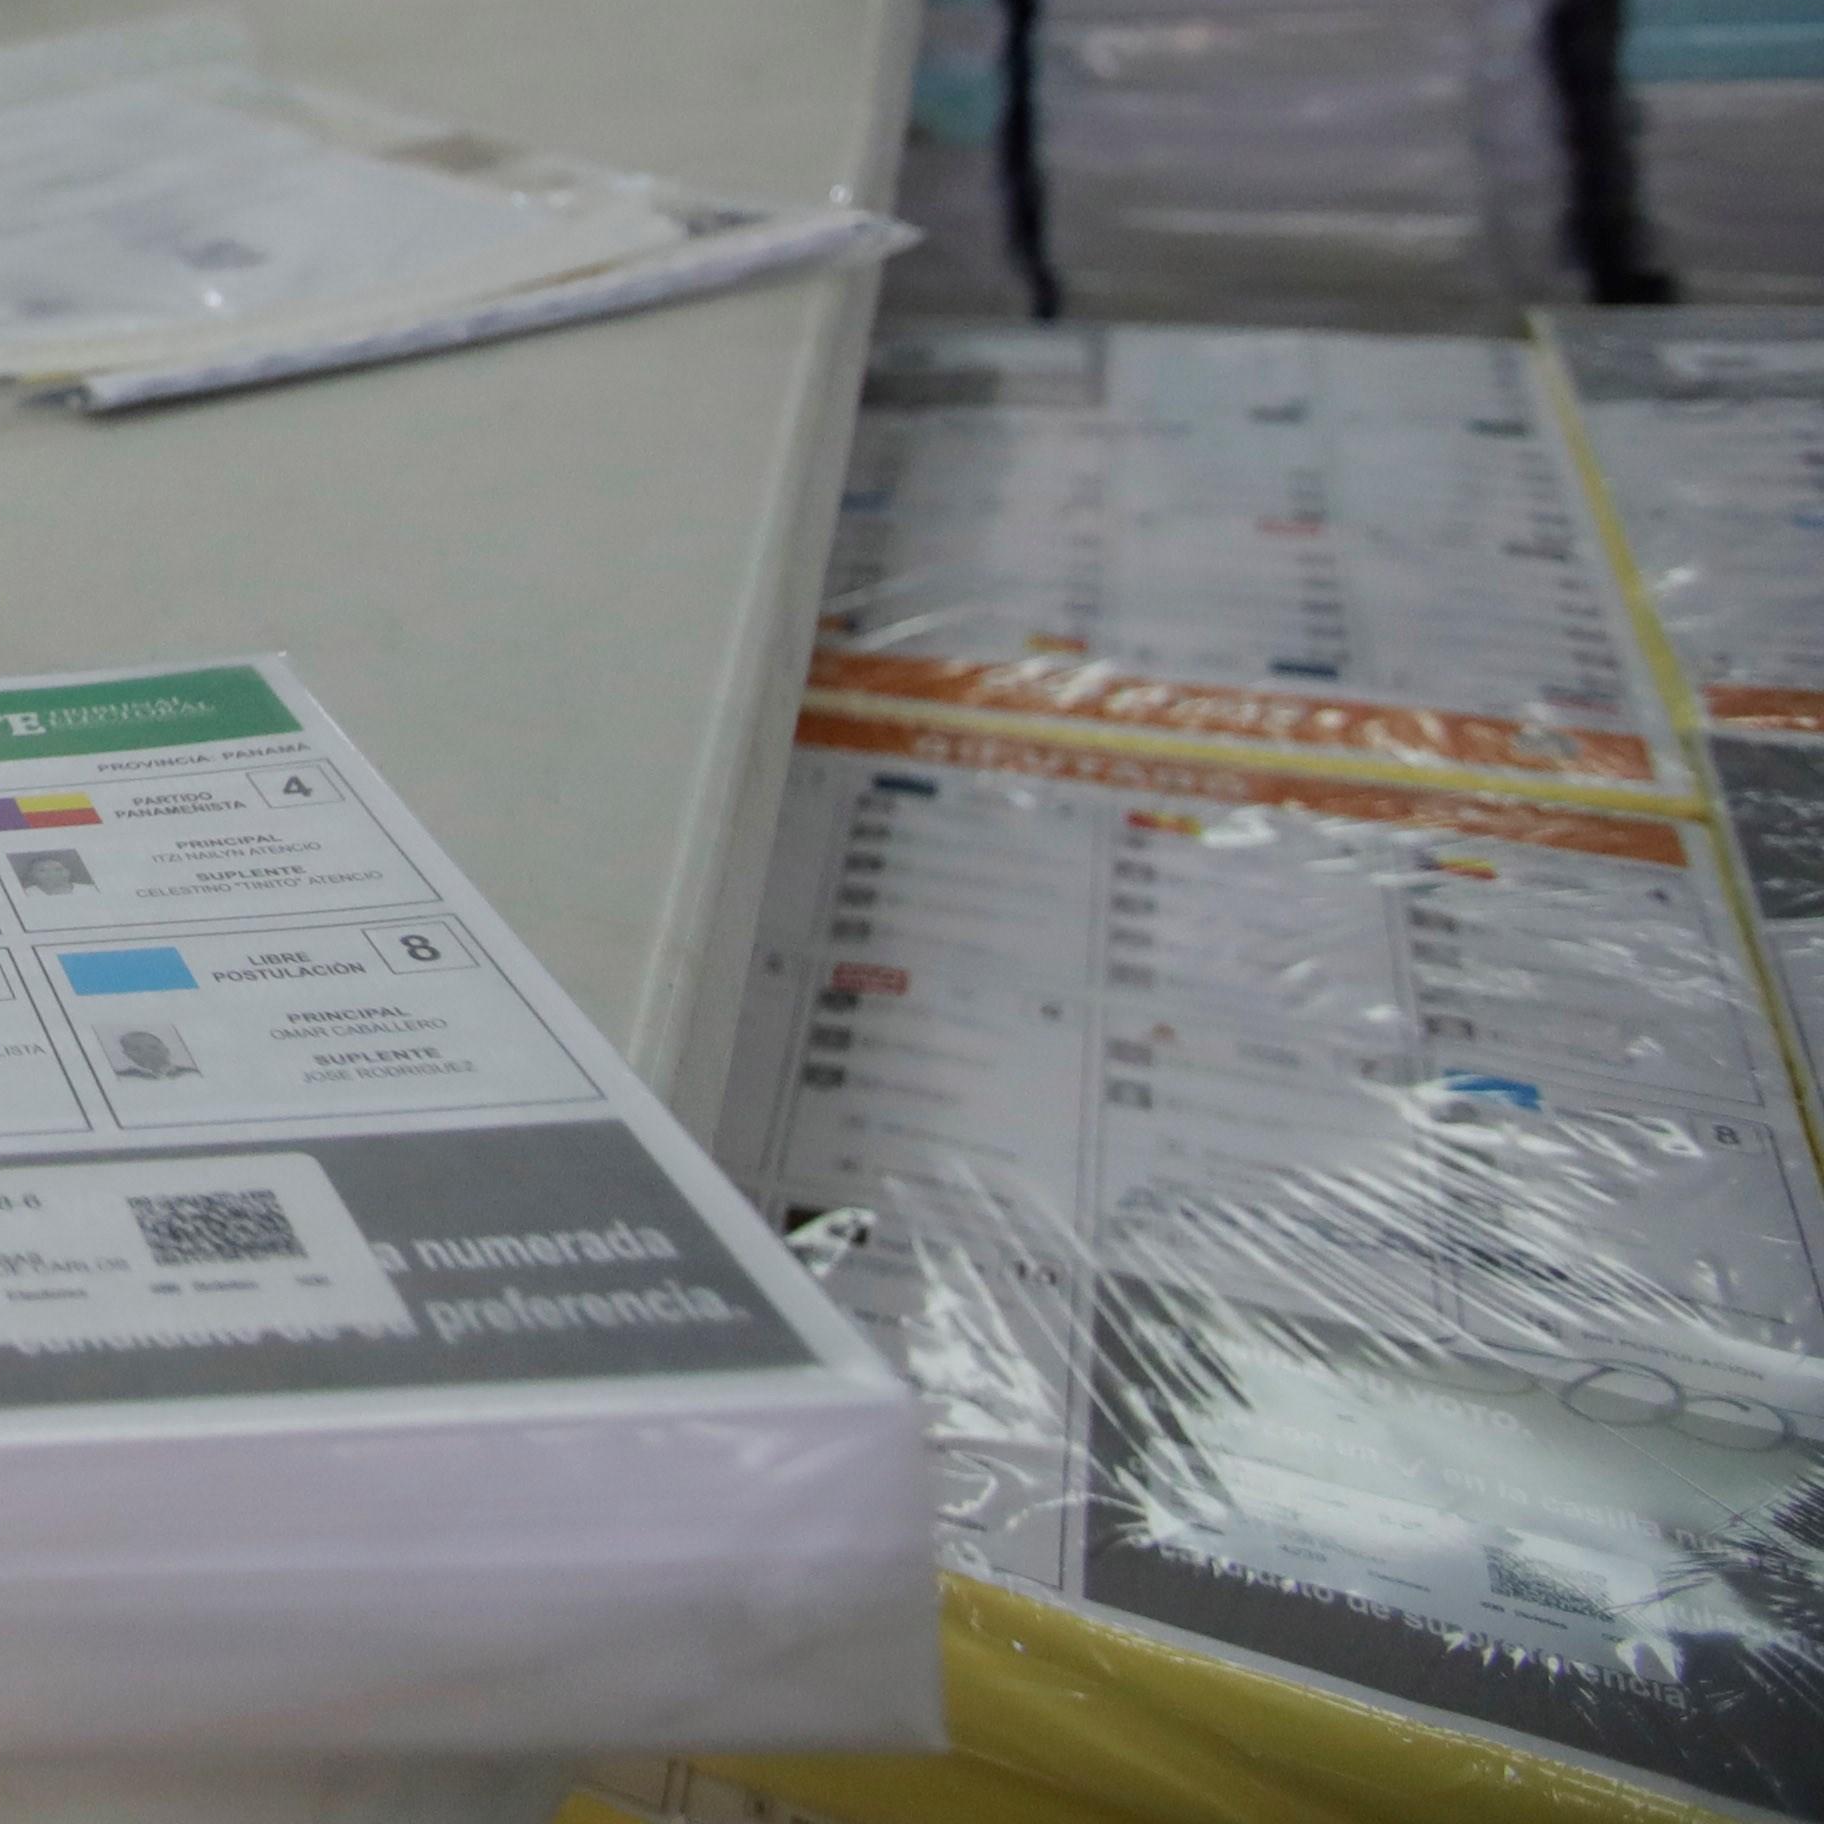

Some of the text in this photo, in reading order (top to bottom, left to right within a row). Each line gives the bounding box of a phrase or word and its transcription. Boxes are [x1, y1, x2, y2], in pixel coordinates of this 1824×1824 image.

[271, 775, 318, 798] 4
[129, 791, 215, 806] PARTIDO
[172, 833, 285, 850] PRINCIPAL
[193, 865, 309, 882] SUPLENTE
[392, 932, 447, 963] 8
[244, 951, 315, 967] LIBRE
[207, 959, 371, 985] POSTULACIÓN
[284, 1005, 414, 1026] PRINCIPAL
[310, 1047, 445, 1068] SUPLENTE
[404, 1218, 686, 1274] numerada
[412, 1273, 759, 1343] preferencia.
